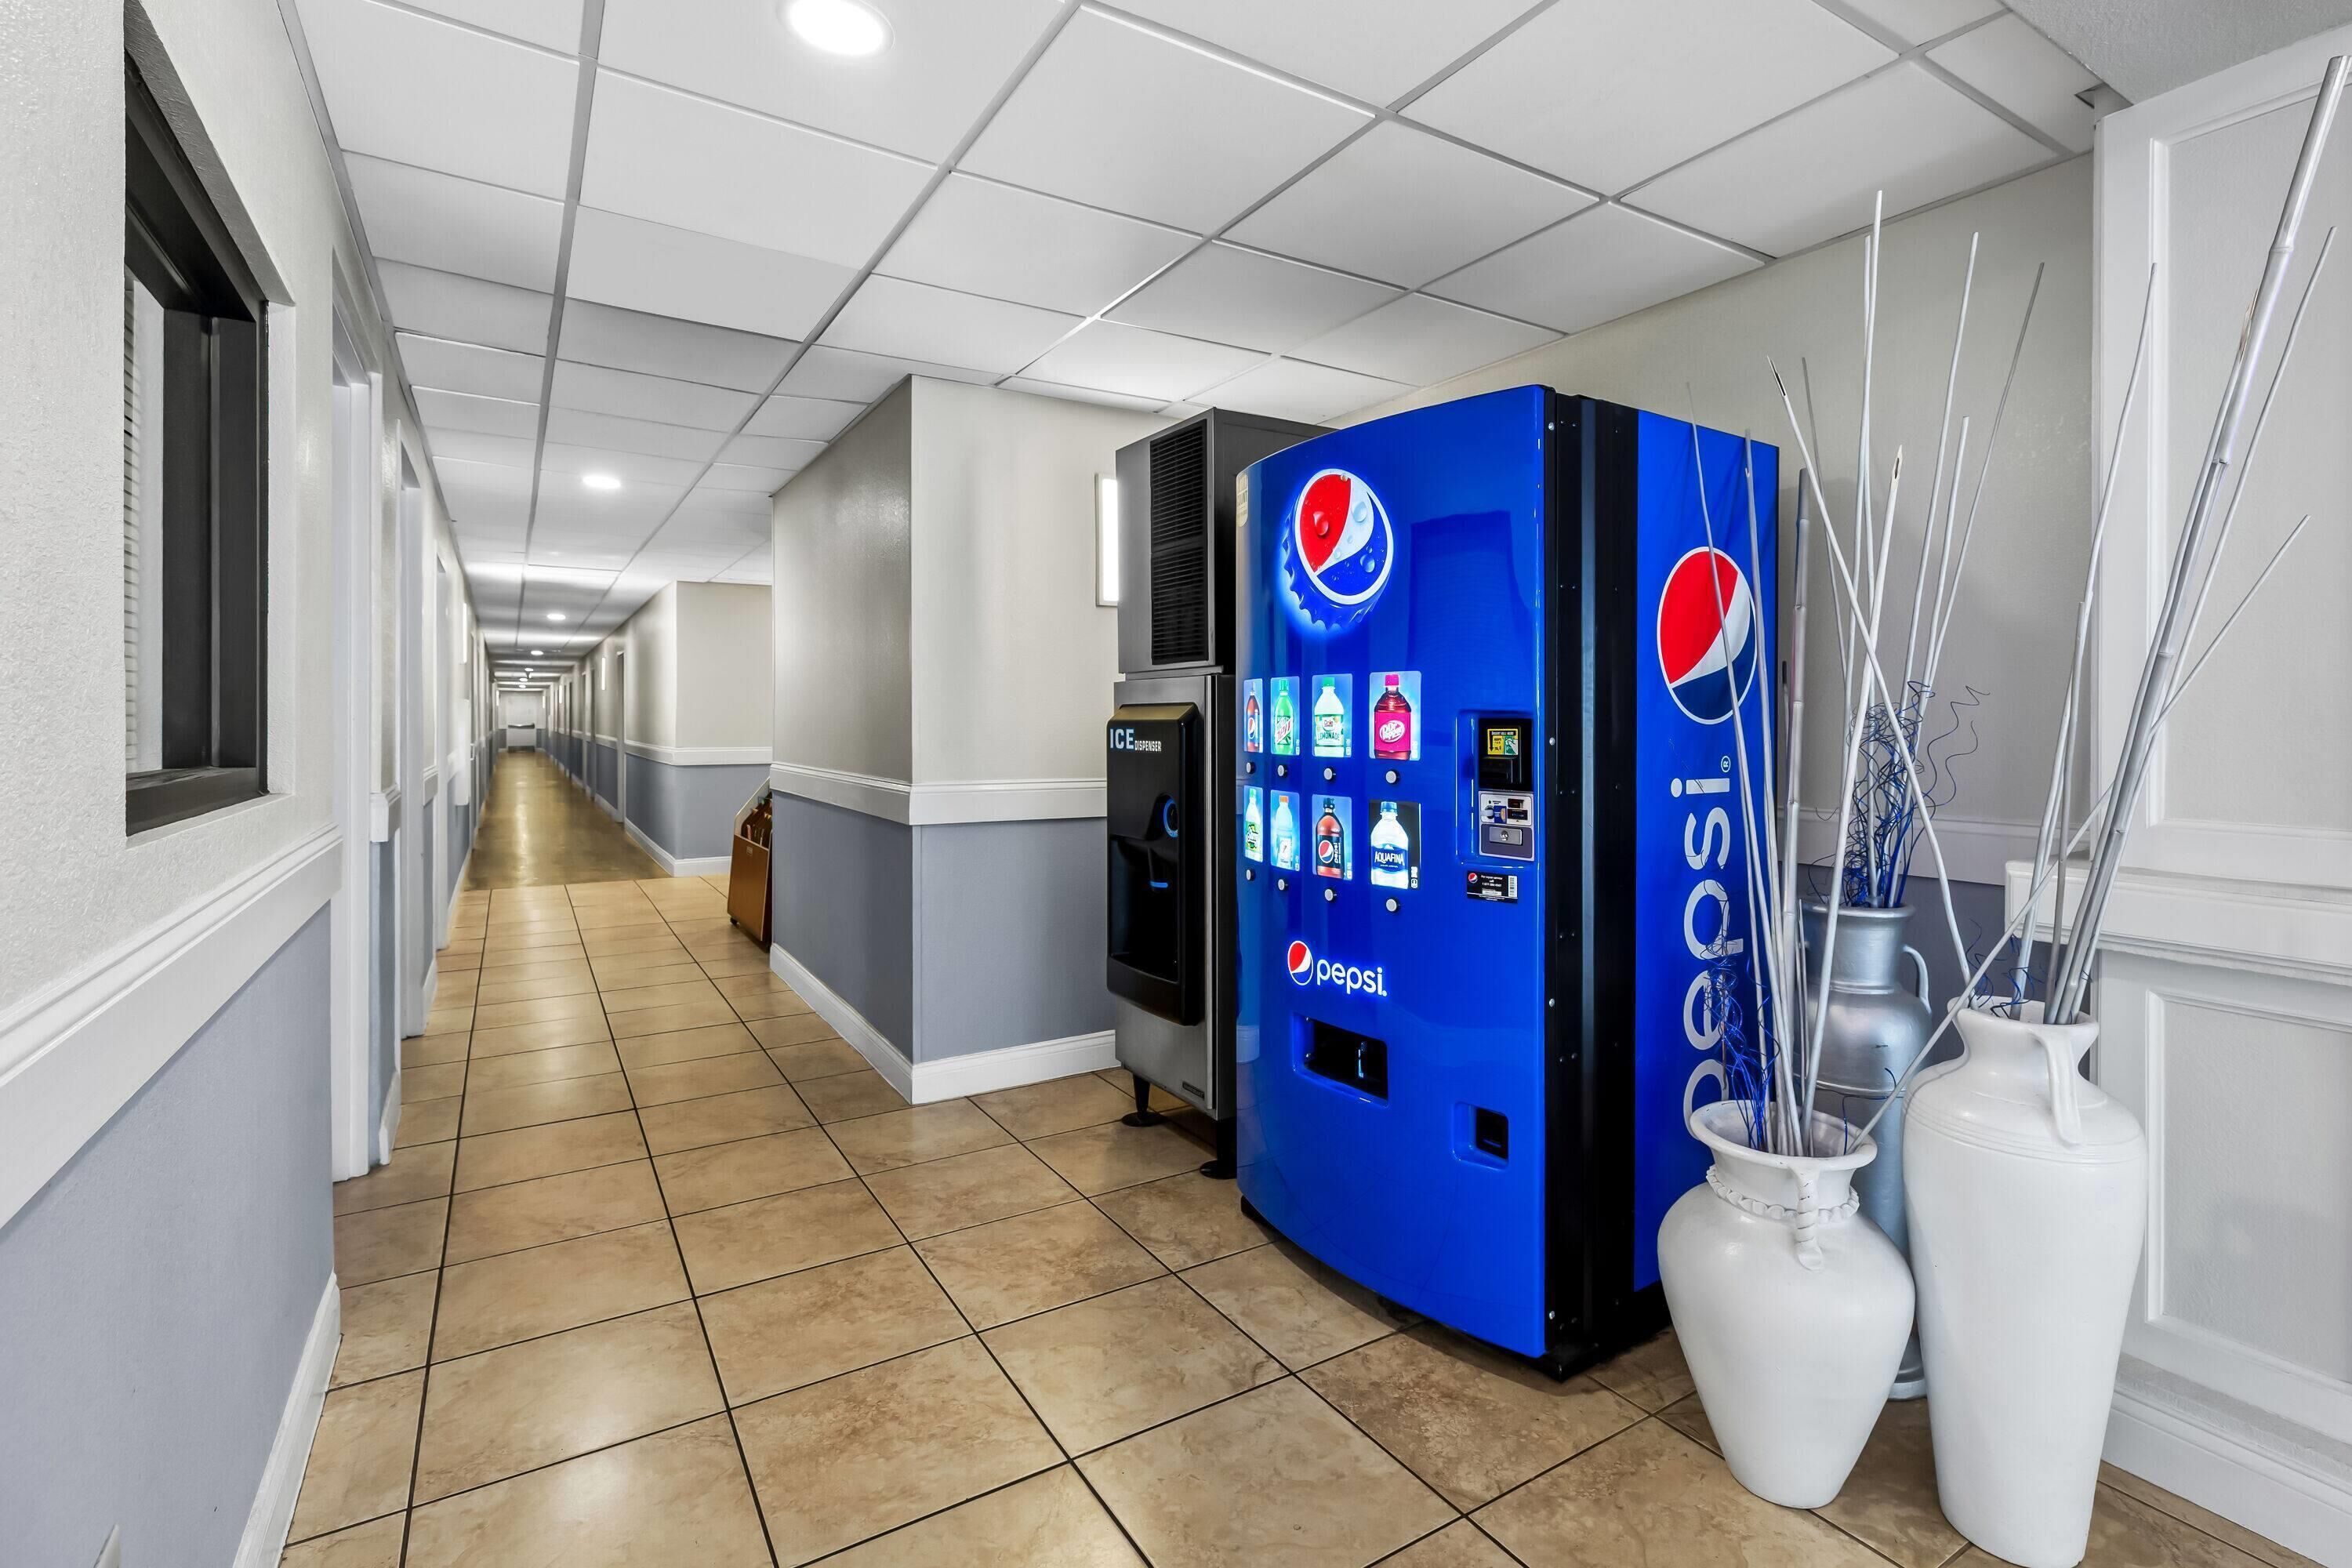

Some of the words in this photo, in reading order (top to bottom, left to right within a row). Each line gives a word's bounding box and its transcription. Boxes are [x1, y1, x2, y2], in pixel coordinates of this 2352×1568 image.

[1109, 728, 1134, 750] ICE
[1134, 740, 1162, 752] DISPENSER
[1317, 731, 1340, 741] LEMONADE
[1374, 851, 1405, 866] AQUAFINA
